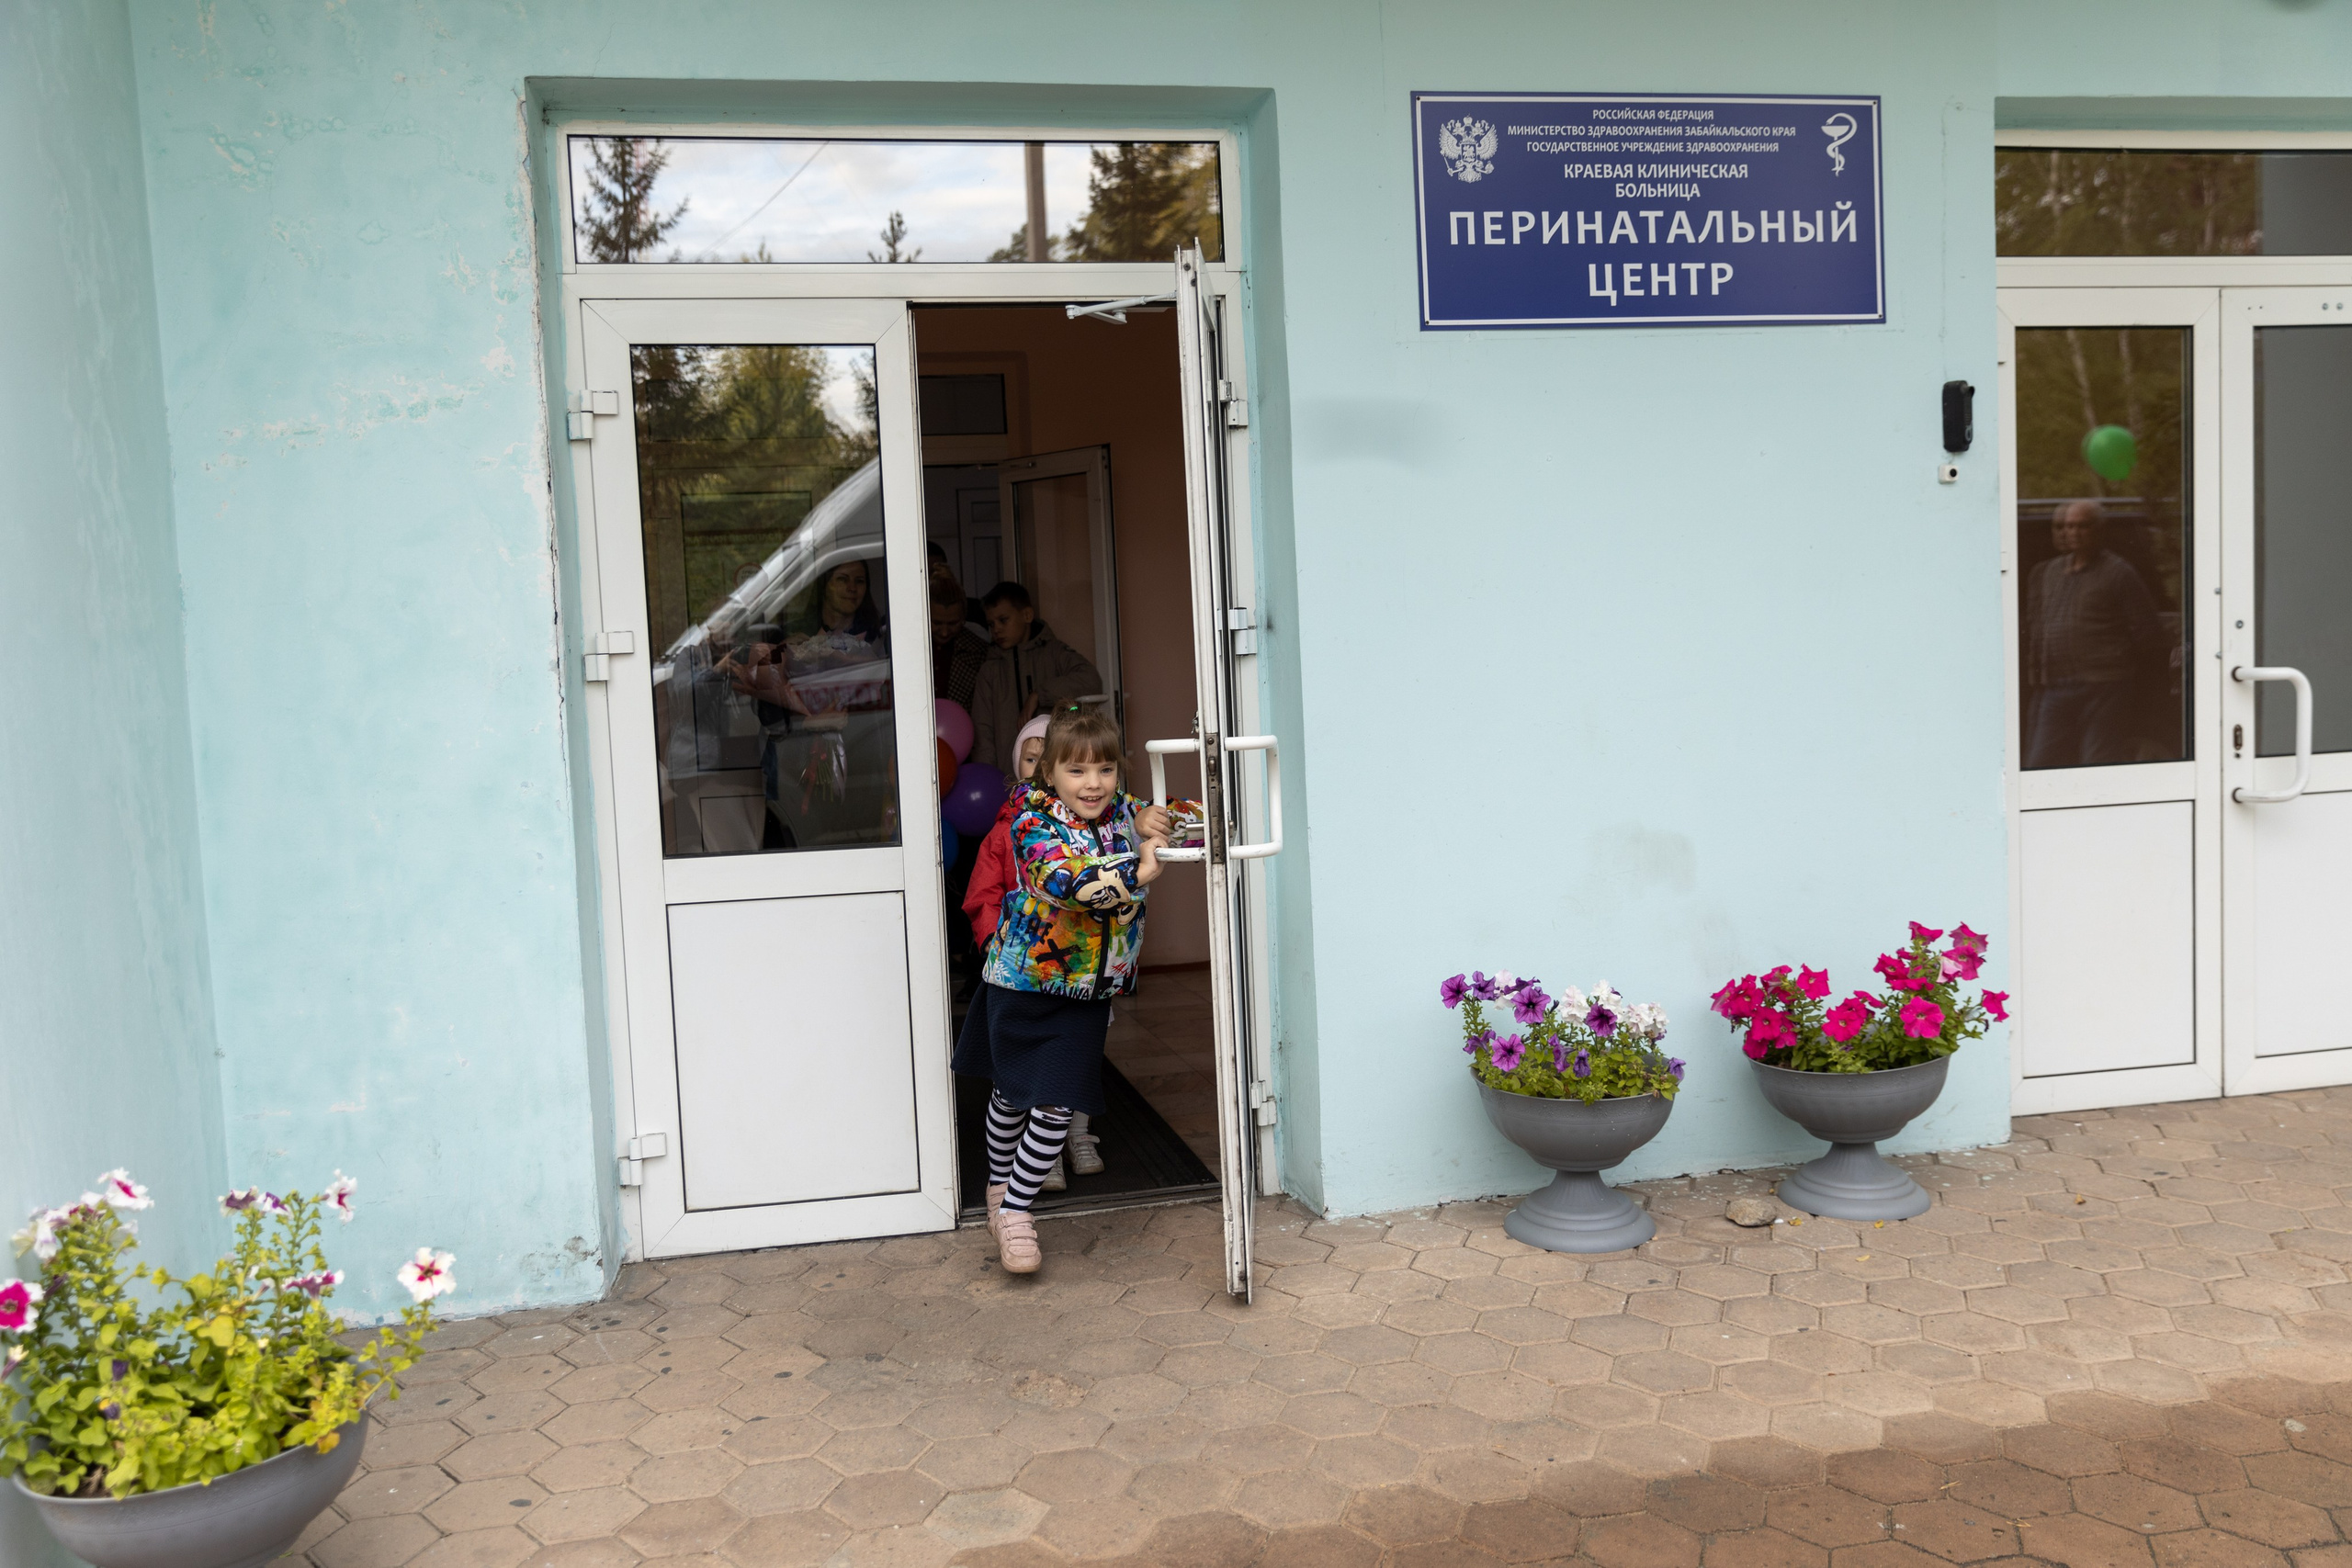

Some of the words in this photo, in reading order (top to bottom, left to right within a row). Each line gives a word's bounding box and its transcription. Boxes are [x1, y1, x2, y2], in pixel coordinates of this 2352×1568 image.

[1592, 107, 1656, 120] РОССИЙСКАЯ
[1657, 109, 1714, 123] ФЕДЕРАЦИЯ
[1507, 125, 1586, 136] МИНИСТЕРСТВО
[1587, 126, 1683, 139] ЗДРАВООХРАНЕНИЯ
[1684, 124, 1771, 137] ЗАБАЙКАЛЬСКОГО
[1771, 126, 1796, 137] КРАЯ
[1526, 141, 1620, 154] ГОСУДАРСТВЕННОЕ
[1621, 141, 1685, 154] УЧРЕЖДЕНИЕ
[1685, 141, 1780, 154] ЗДРАВООХРАНЕНИЯ
[1564, 164, 1634, 179] КРАЕВАЯ
[1637, 164, 1748, 179] КЛИНИЧЕСКАЯ
[1615, 183, 1702, 201] БОЛЬНИЦА
[1449, 200, 1858, 245] ПЕРИНАТАЛЬНЫЙ
[1588, 262, 1735, 307] ЦЕНТР
